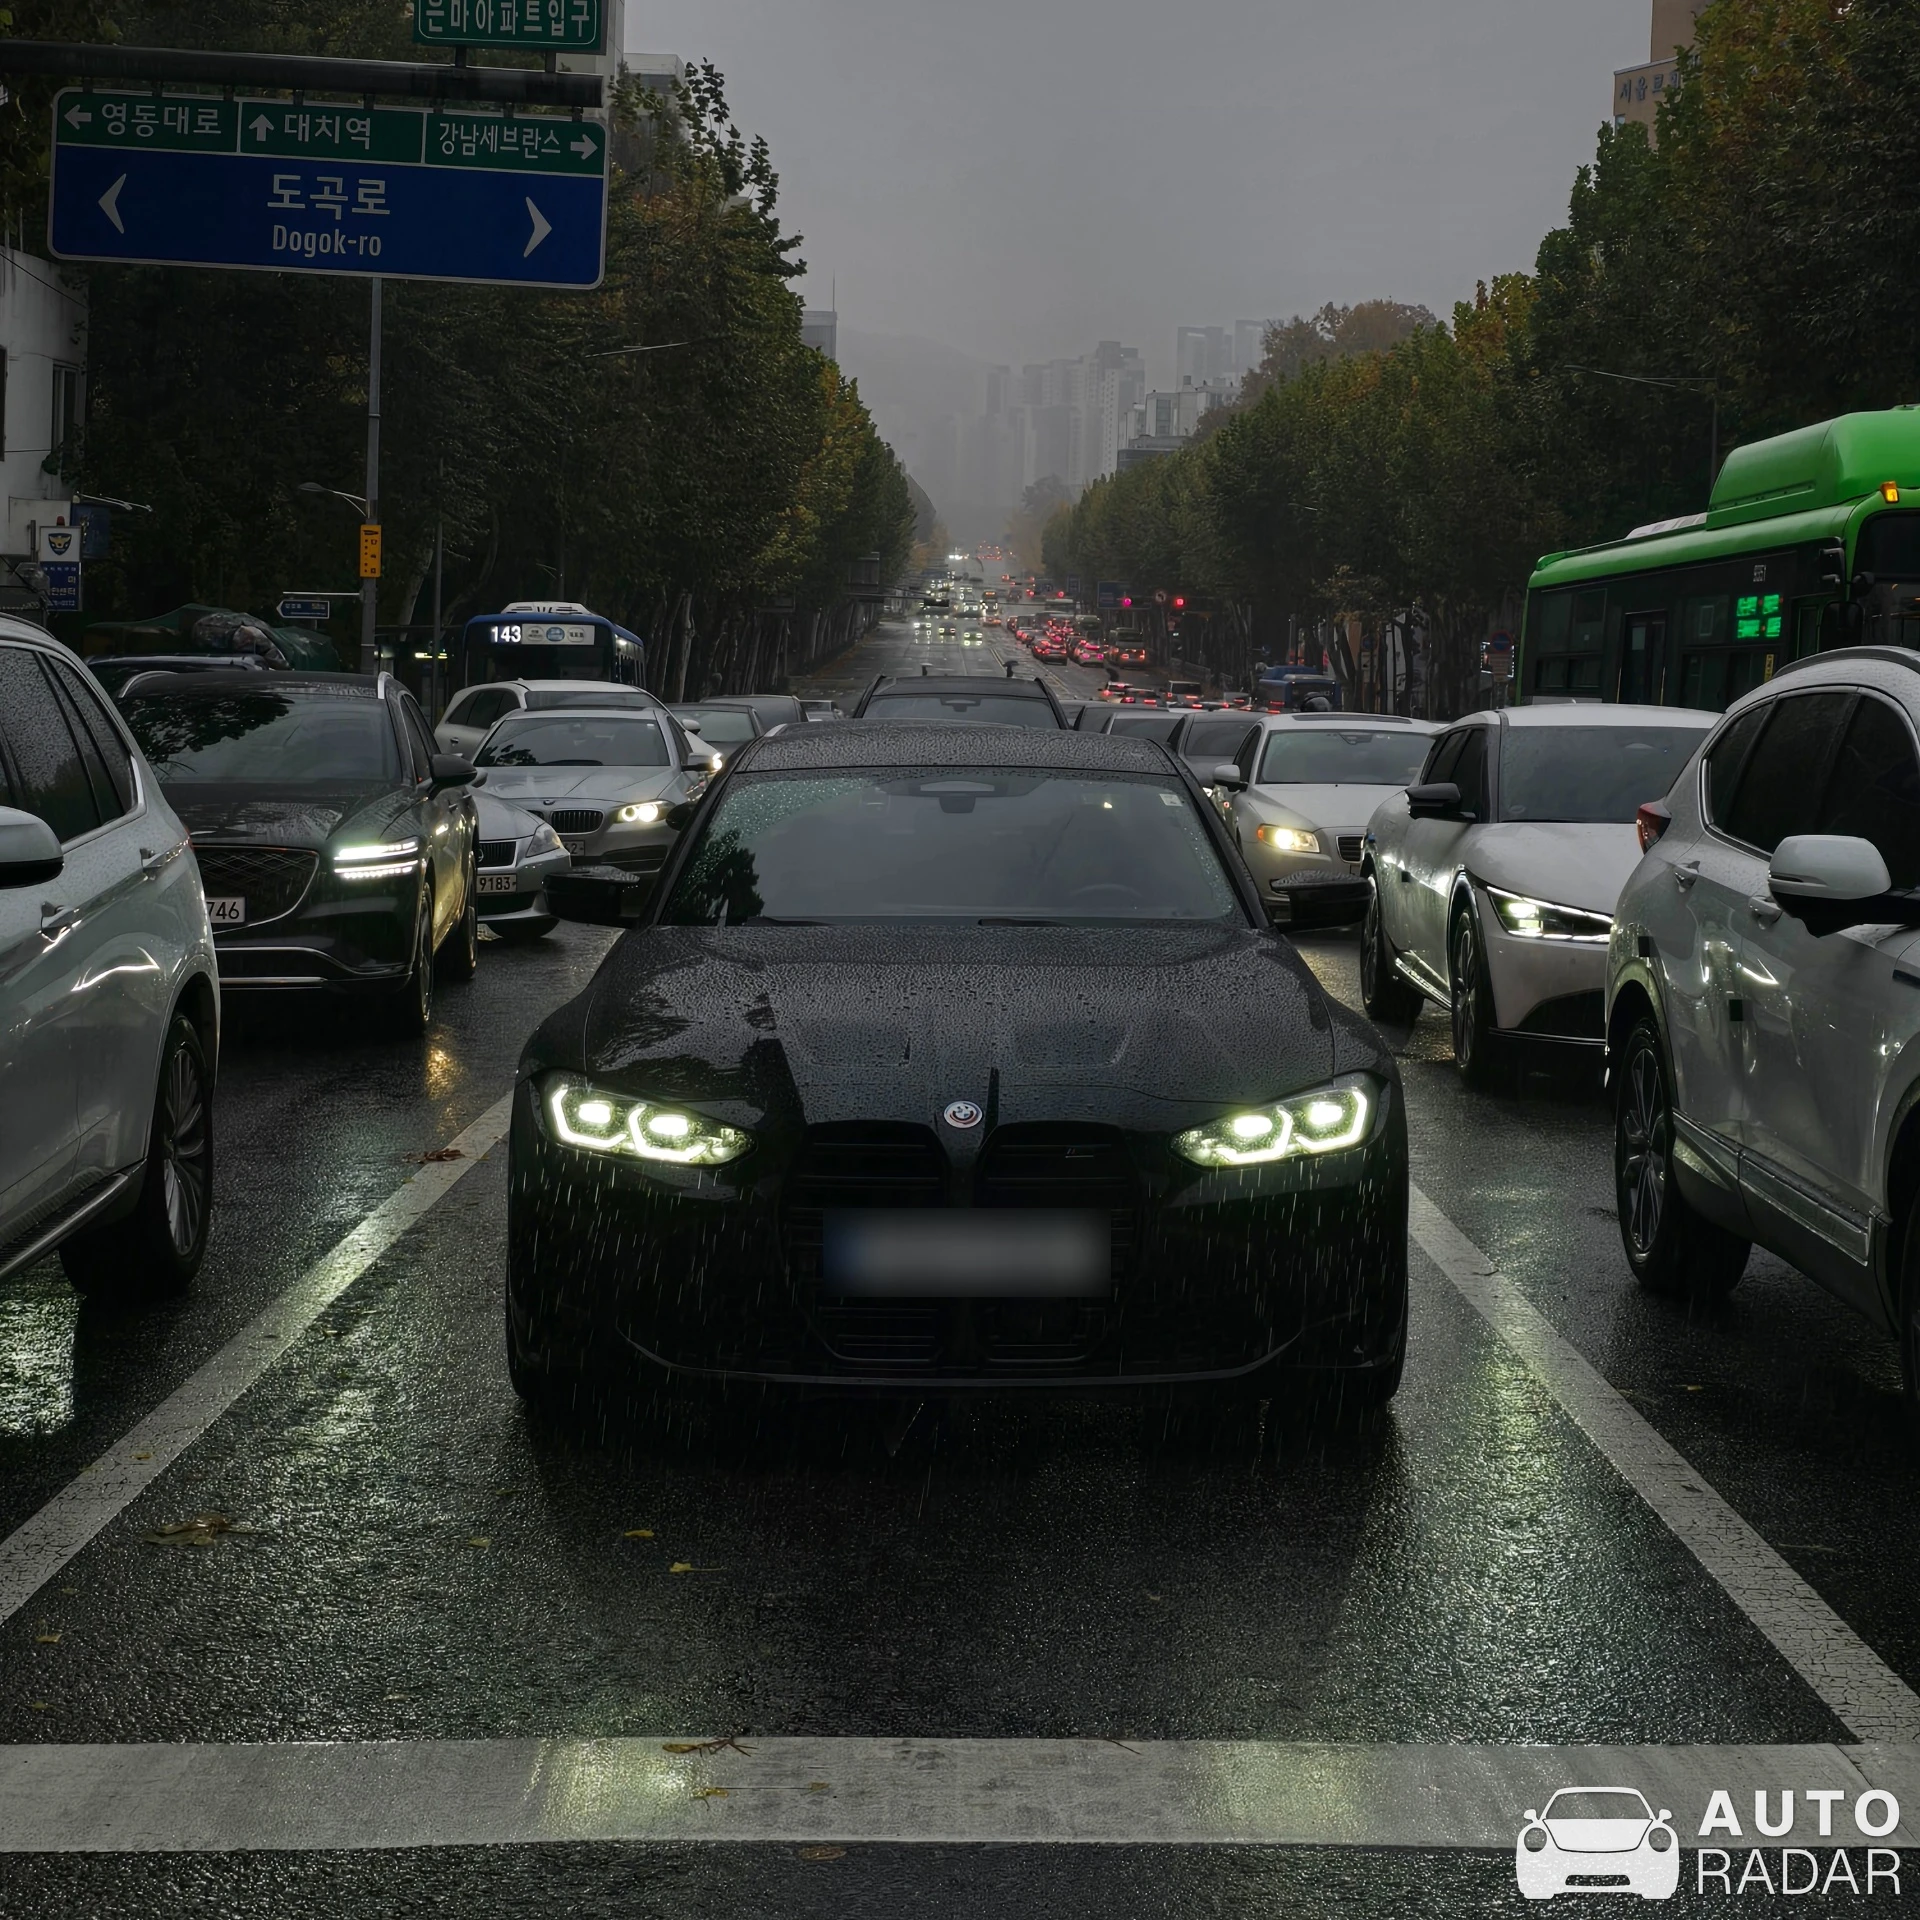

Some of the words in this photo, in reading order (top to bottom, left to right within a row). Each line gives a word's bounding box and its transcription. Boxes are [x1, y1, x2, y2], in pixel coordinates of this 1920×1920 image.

[425, 0, 590, 38] 은마아파트입구
[101, 102, 222, 138] 영동대로
[283, 113, 372, 151] 대치역
[438, 122, 562, 160] 강남세브란스
[266, 173, 391, 221] 도곡로
[272, 224, 383, 259] Dogok-ro
[490, 625, 522, 643] 143
[479, 876, 512, 892] 9183
[206, 901, 240, 920] 746
